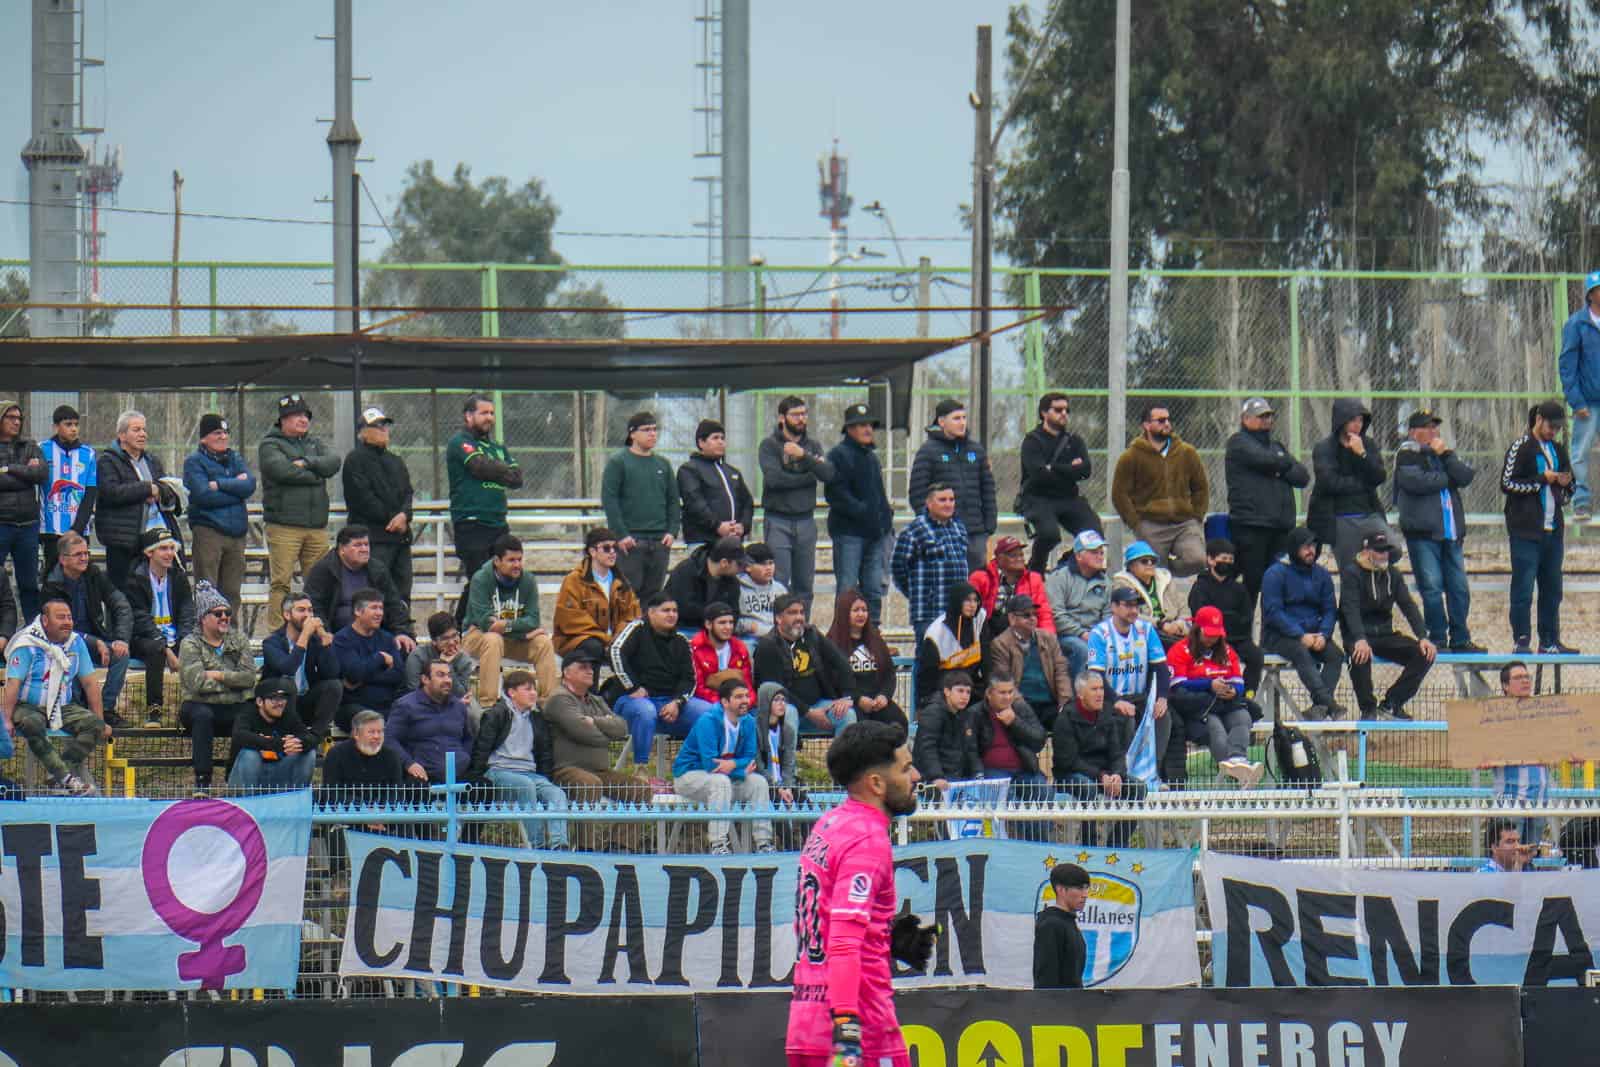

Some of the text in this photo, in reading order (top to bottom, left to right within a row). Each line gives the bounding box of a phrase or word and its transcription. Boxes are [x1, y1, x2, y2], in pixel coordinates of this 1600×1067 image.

[0, 823, 104, 969] TE
[1042, 904, 1136, 925] allanes
[1222, 877, 1597, 987] RENCA
[1153, 1021, 1408, 1067] ENERGY
